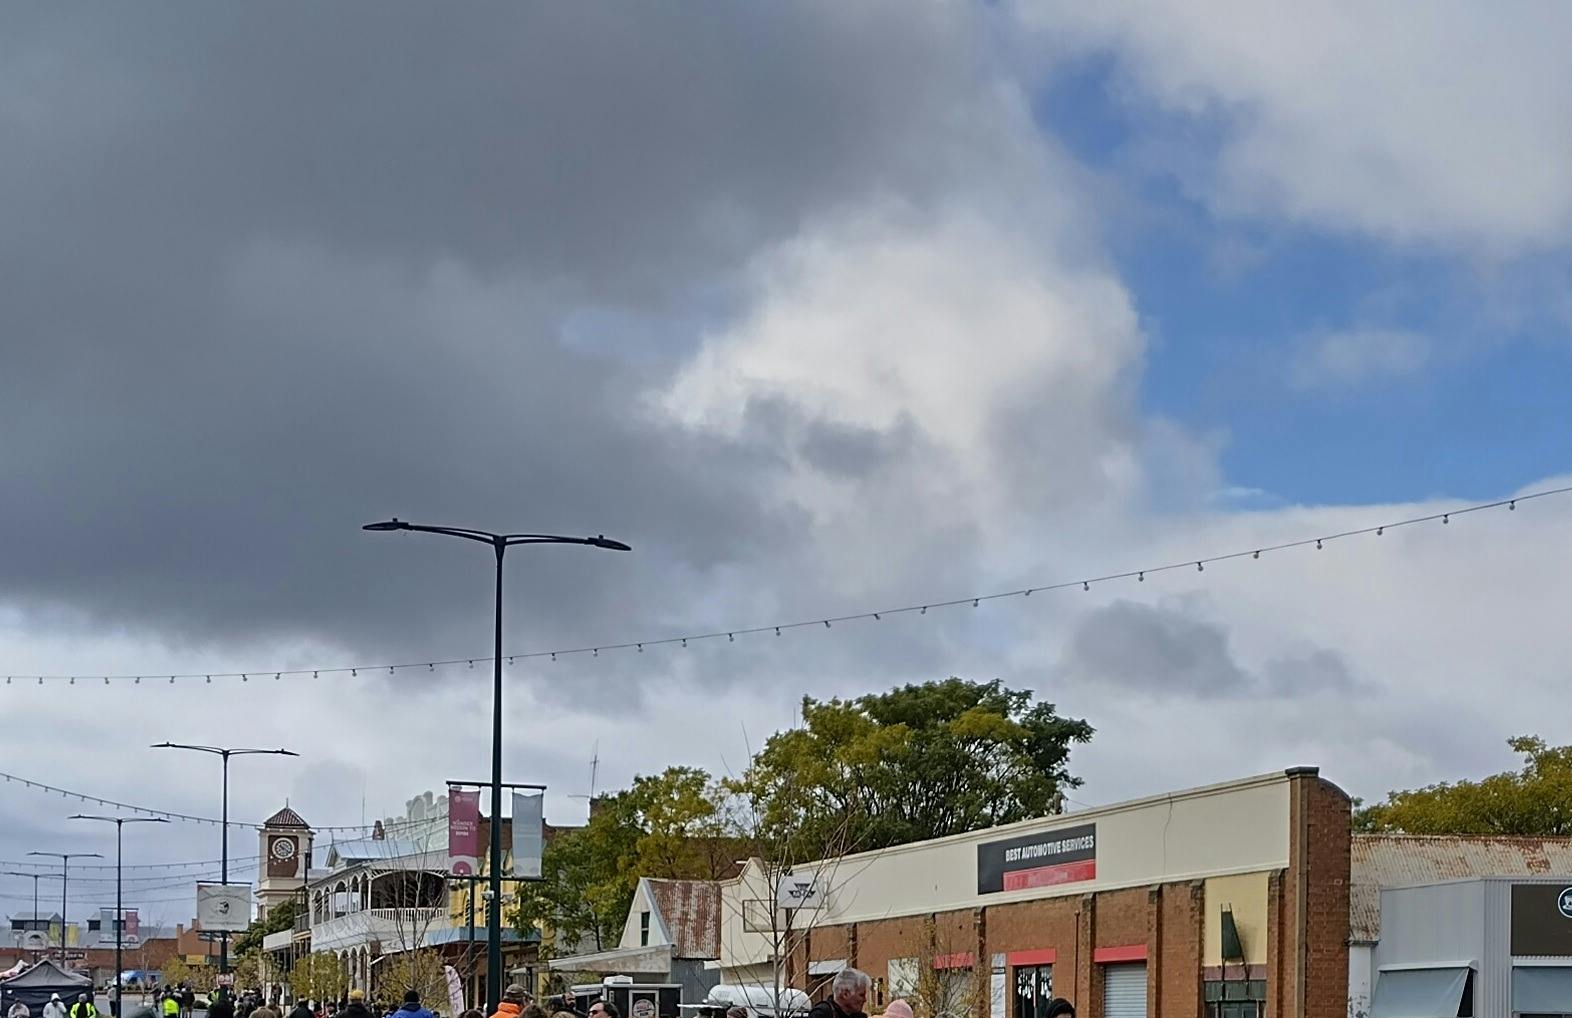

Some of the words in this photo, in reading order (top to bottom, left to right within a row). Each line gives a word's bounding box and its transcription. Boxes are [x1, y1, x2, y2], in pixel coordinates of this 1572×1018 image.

[1005, 848, 1021, 862] BEST
[1021, 841, 1061, 860] AUTOMOTIVE
[1062, 835, 1094, 852] SERVICES
